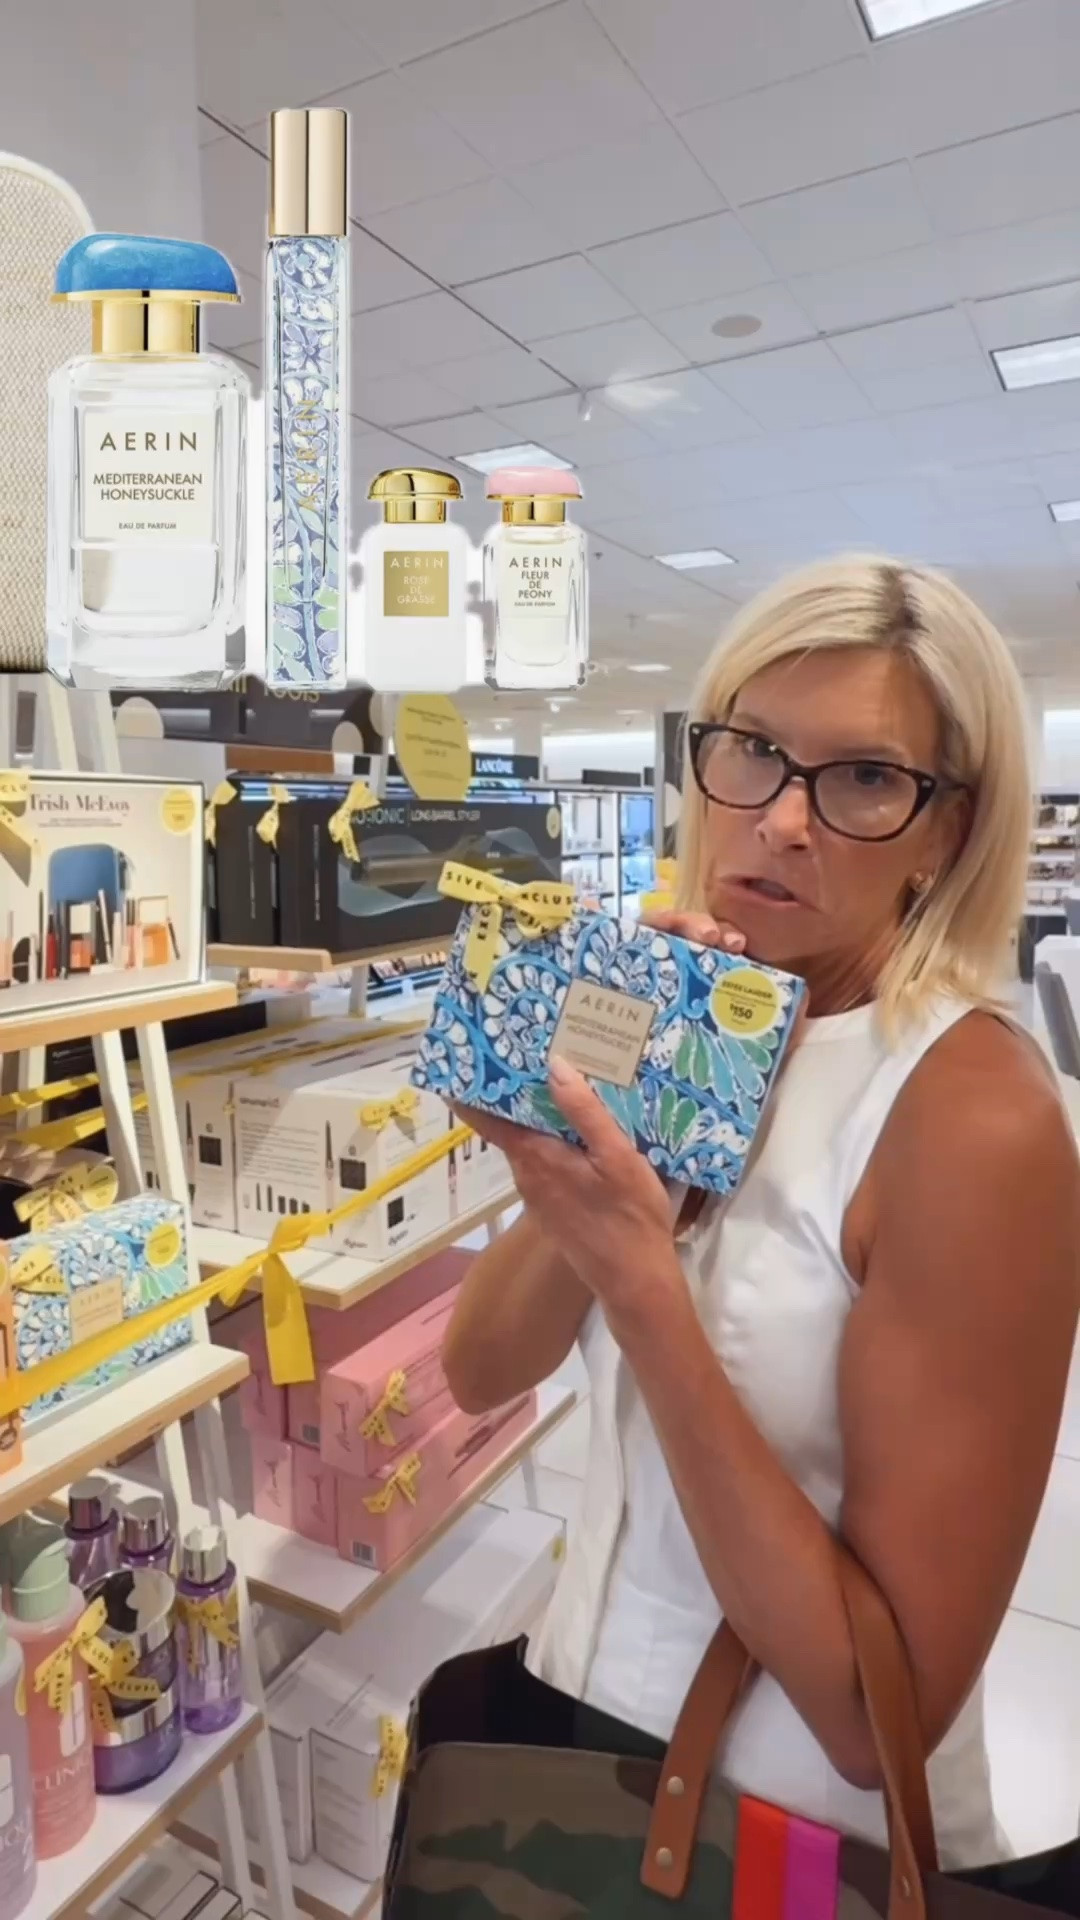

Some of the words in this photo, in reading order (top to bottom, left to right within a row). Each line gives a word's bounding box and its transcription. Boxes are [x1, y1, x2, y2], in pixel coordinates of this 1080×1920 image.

[30, 793, 70, 812] Trish
[76, 794, 131, 817] McEvoy
[578, 993, 640, 1022] AERIN
